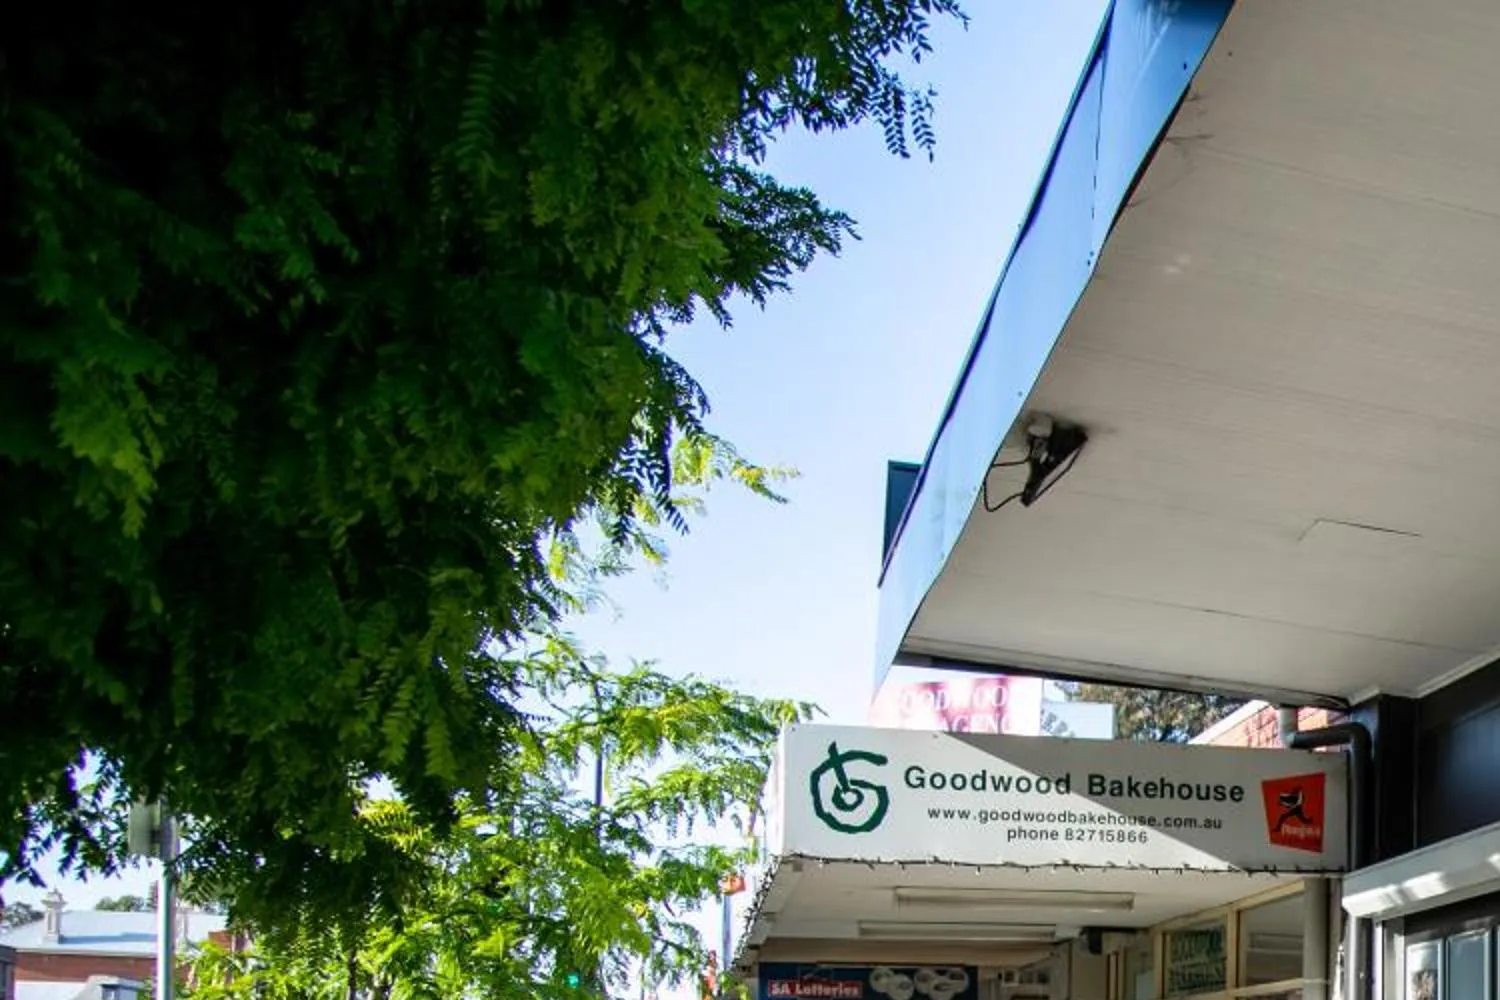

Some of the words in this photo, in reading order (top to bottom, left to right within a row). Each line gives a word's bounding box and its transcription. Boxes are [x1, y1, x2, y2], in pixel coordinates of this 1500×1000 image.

[904, 765, 1071, 795] Goodwood
[1087, 773, 1245, 803] Bakehouse
[927, 807, 1223, 830] www.goodwoodbakehouse.com.au
[1006, 826, 1059, 843] phone
[1064, 827, 1149, 844] 82715866
[771, 982, 791, 995] SA
[796, 982, 860, 998] Lotteries
